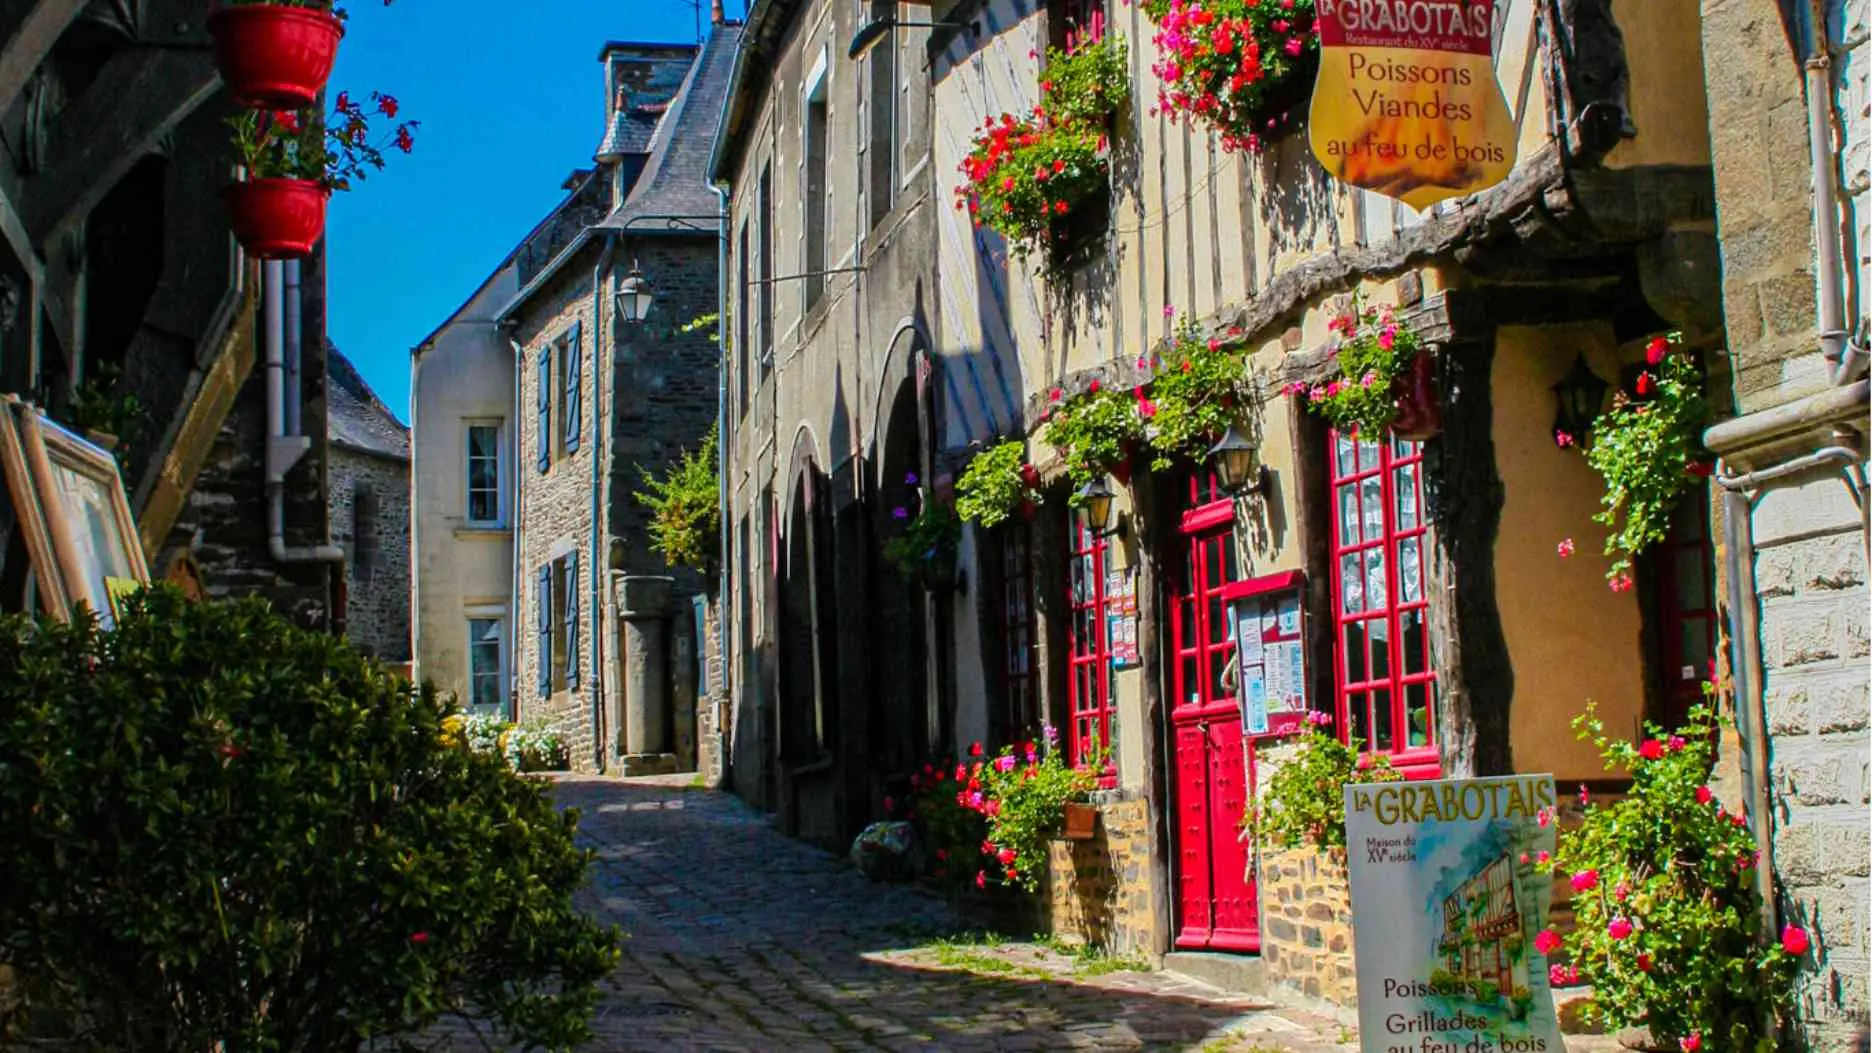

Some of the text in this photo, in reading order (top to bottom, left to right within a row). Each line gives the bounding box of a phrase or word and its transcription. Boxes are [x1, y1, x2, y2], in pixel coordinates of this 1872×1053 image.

[1337, 0, 1488, 38] GRABOTAIS
[1345, 31, 1401, 48] Restaurant
[1403, 34, 1419, 48] du
[1349, 52, 1472, 86] Poissons
[1351, 88, 1472, 121] Viandes
[1327, 131, 1504, 163] au feu de bois
[1353, 779, 1553, 825] LA GRABOTAIS
[1366, 835, 1416, 848] Maison du
[1384, 978, 1477, 999] Poissons
[1386, 1009, 1488, 1034] Grillades
[1420, 1035, 1458, 1053] feu
[1465, 1033, 1493, 1053] de
[1501, 1032, 1546, 1053] bois
